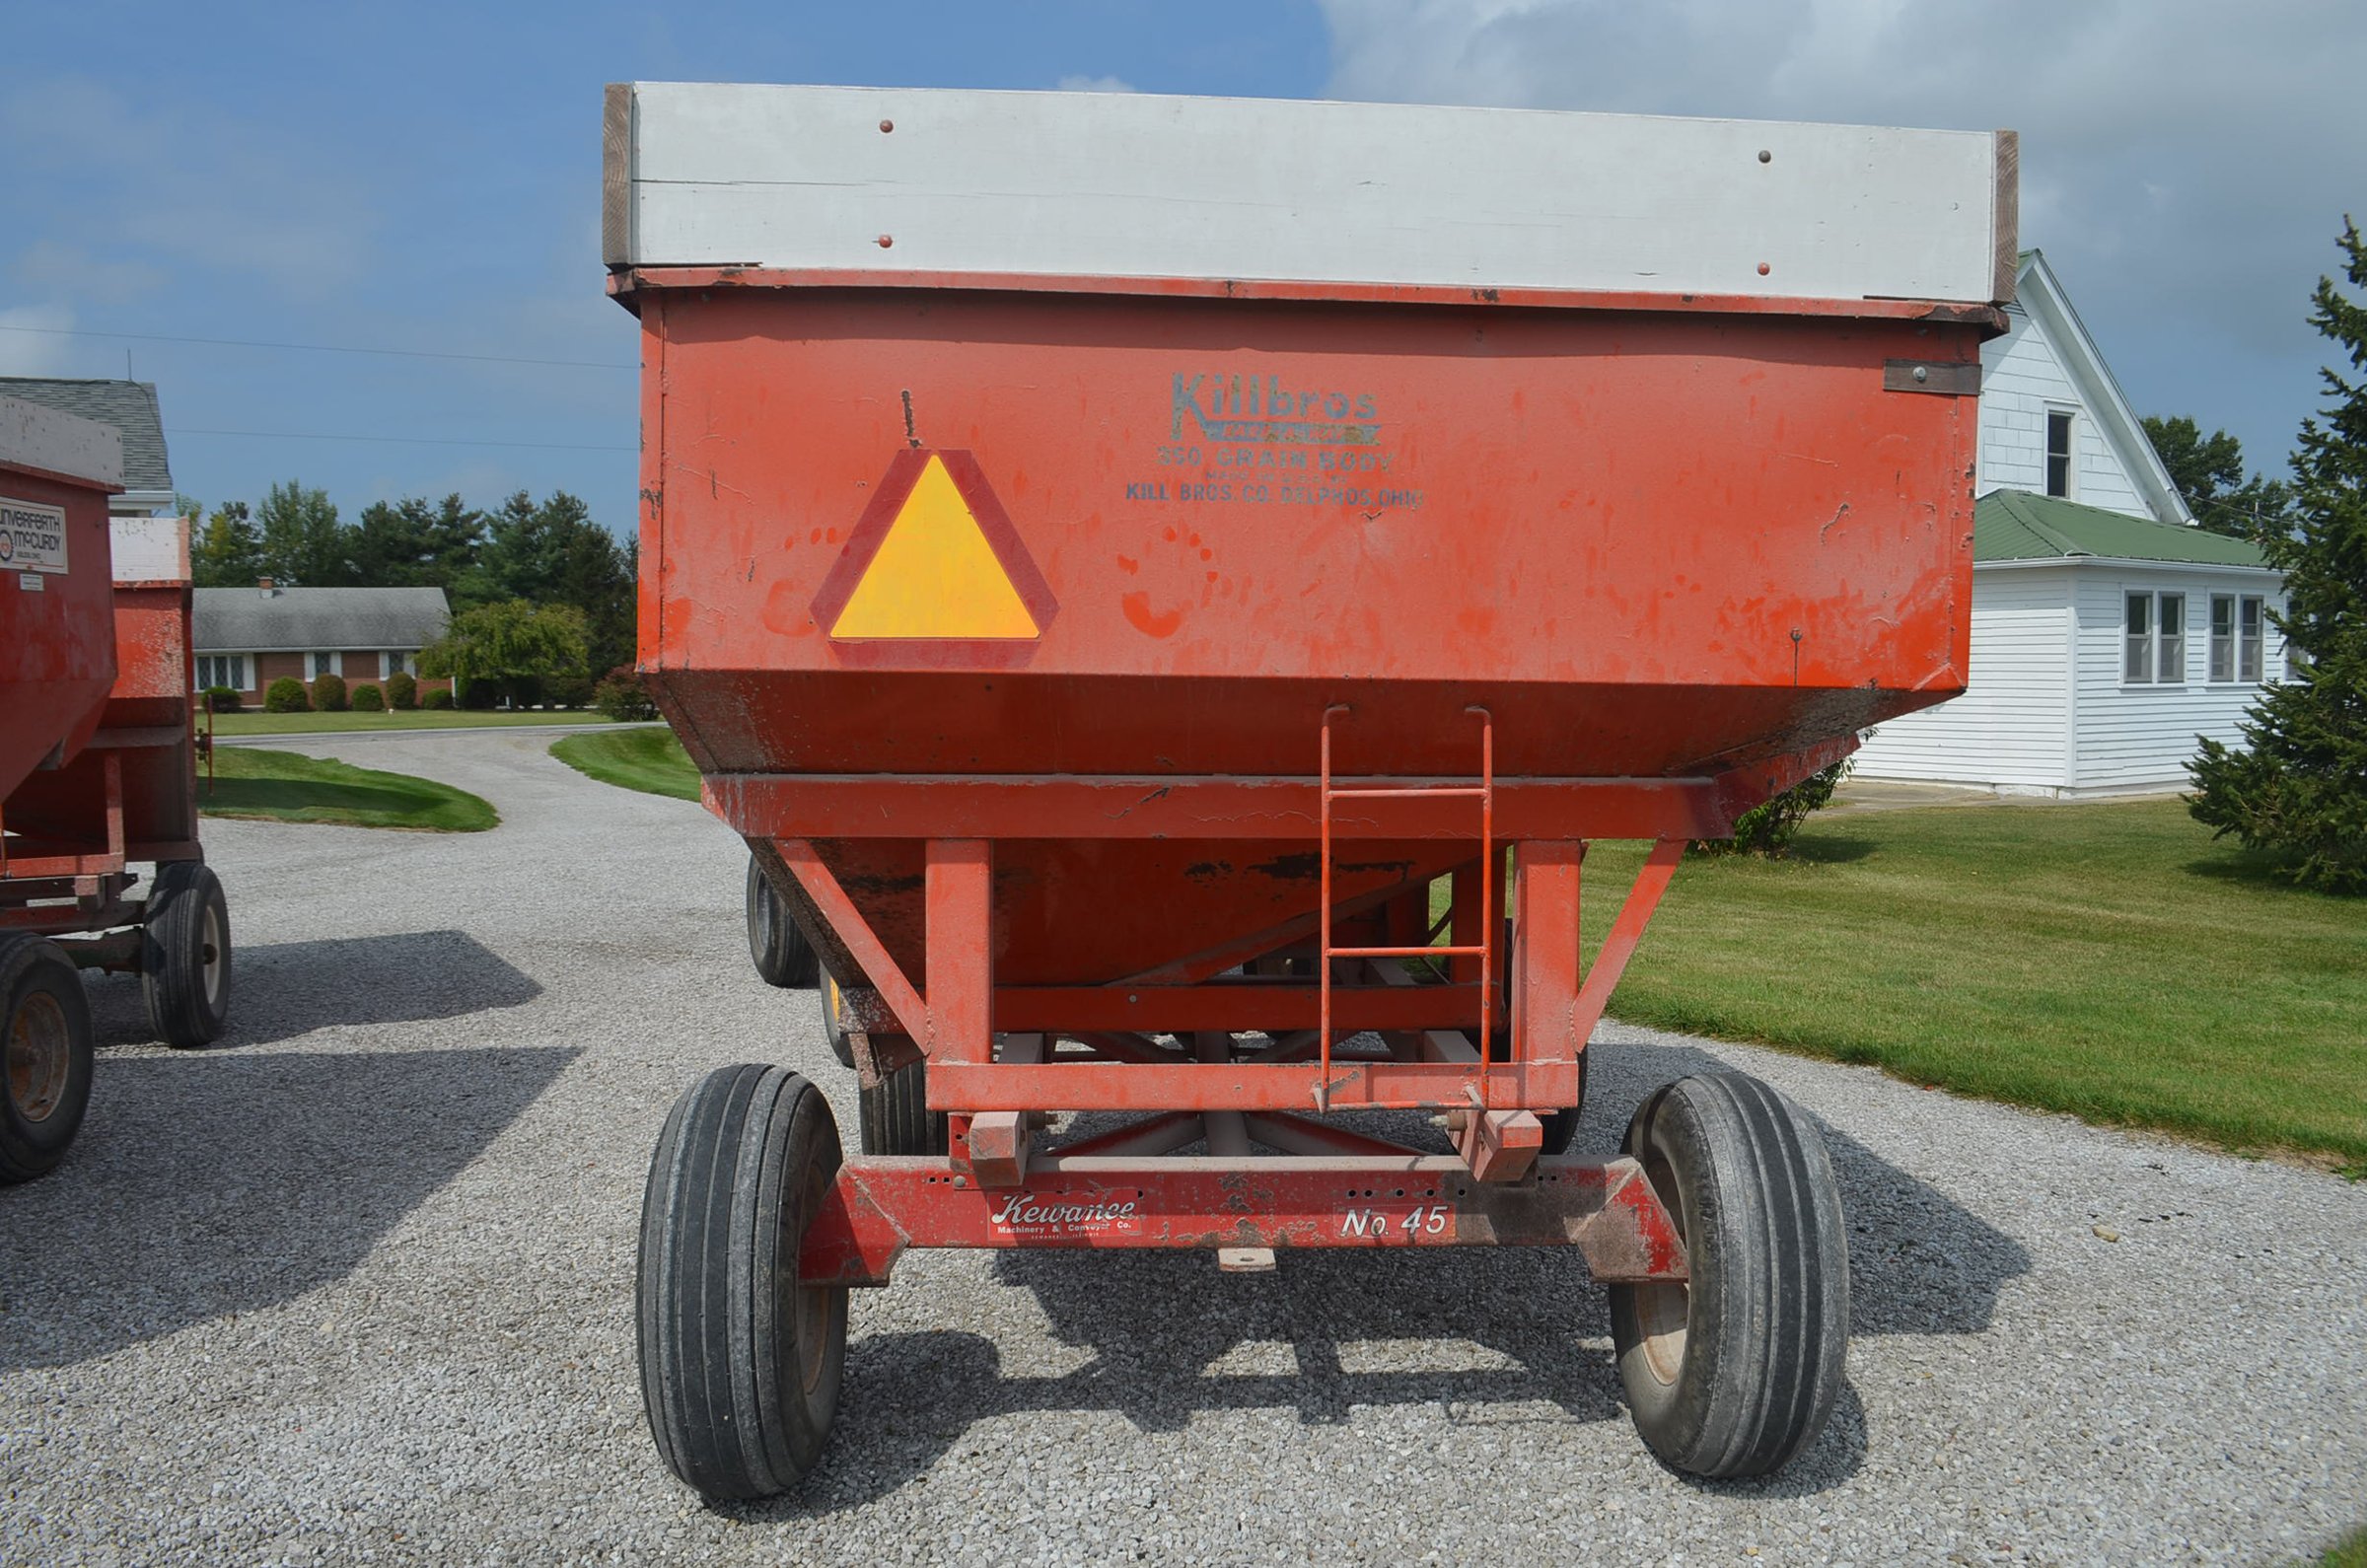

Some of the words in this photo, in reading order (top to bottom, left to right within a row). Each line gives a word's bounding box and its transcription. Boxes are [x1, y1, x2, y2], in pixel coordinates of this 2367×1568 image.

[1171, 372, 1378, 440] Killbros
[1156, 446, 1201, 465] 350
[1217, 448, 1307, 468] GRAIN
[1319, 451, 1395, 471] BODY
[1126, 482, 1170, 501] KILL
[991, 1194, 1136, 1224] Kewanee
[1340, 1207, 1390, 1238] No.
[1399, 1204, 1450, 1235] 45
[997, 1225, 1045, 1234] Machinery
[1051, 1224, 1060, 1233] &
[1116, 1220, 1132, 1230] Co.
